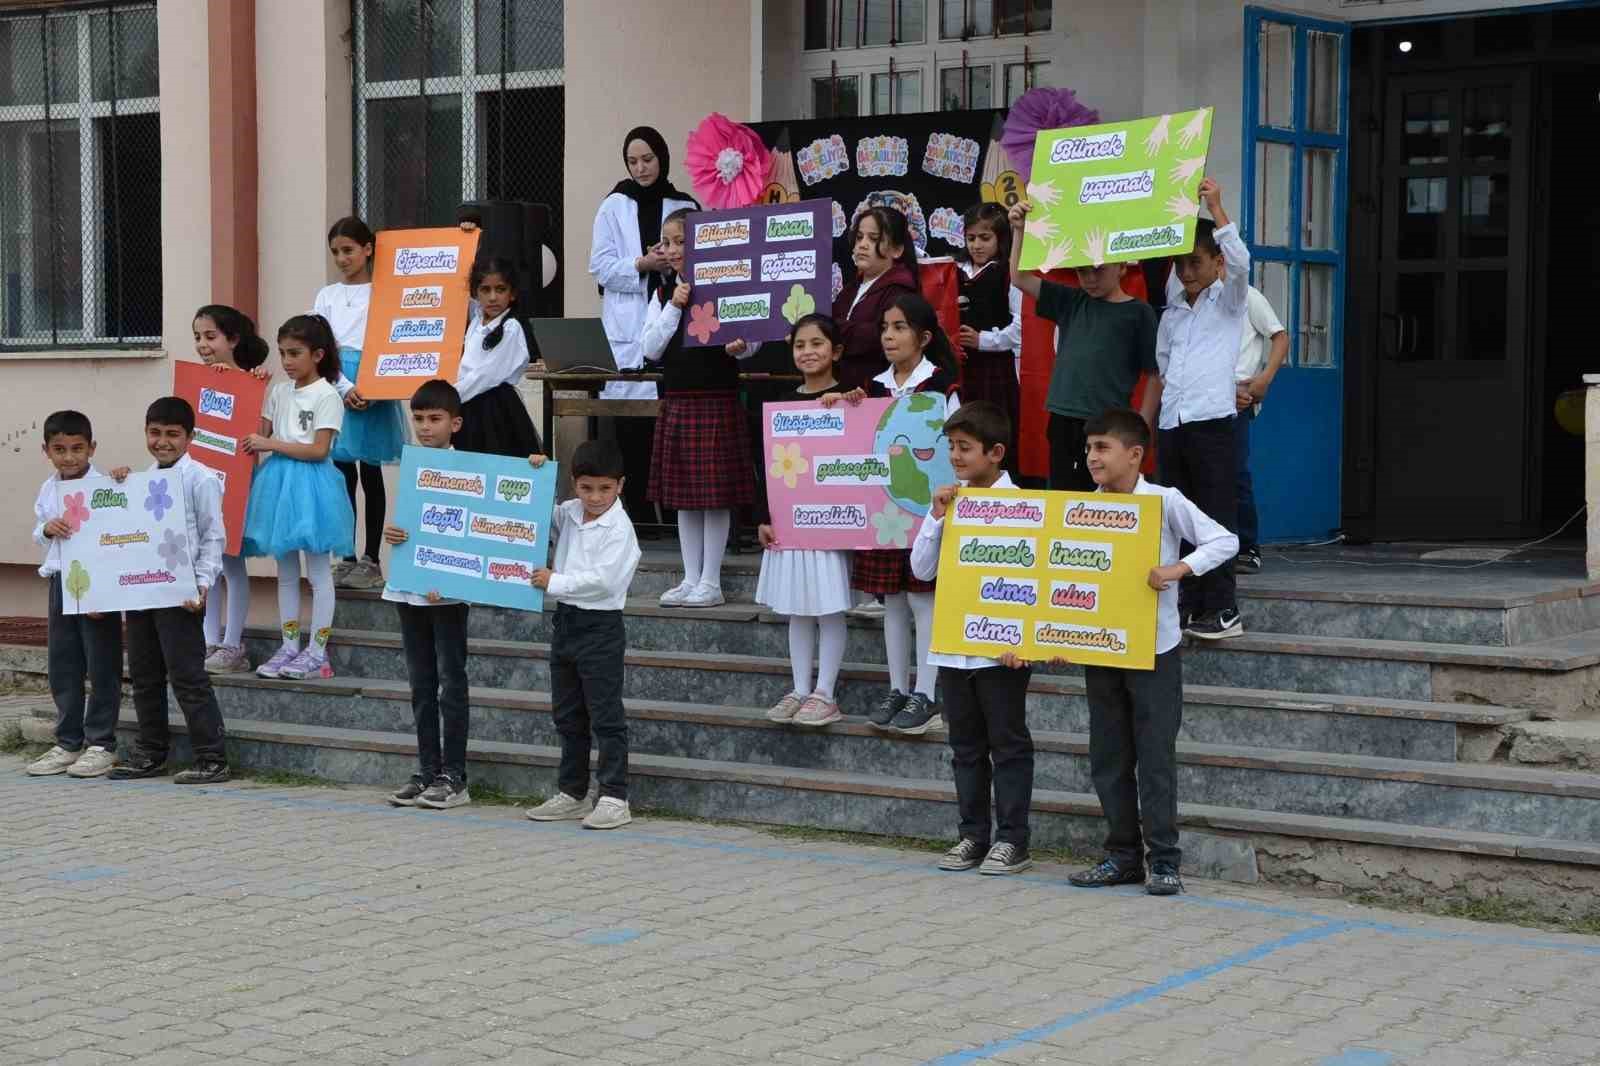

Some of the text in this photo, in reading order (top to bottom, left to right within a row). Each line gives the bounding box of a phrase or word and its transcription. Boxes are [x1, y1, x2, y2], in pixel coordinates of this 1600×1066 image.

[1052, 135, 1124, 163] Bilmek
[1080, 171, 1153, 203] yapmak
[697, 222, 749, 247] Bilgisiz
[767, 217, 812, 239] insan
[396, 250, 457, 274] Öğrenim
[695, 259, 750, 285] meyvesiz
[762, 251, 815, 280] ağaca
[402, 288, 441, 307] aklın
[719, 298, 769, 320] benzer
[390, 320, 443, 342] gücünü
[772, 413, 843, 435] İlköğretim
[816, 457, 889, 483] geleceğin
[418, 469, 531, 502] Bilmemek ayıp
[90, 488, 128, 510] Bilen
[794, 506, 866, 528] temelidir
[957, 497, 1138, 530] İlköğretim davası
[471, 516, 535, 542] bilmediğini
[416, 547, 482, 573] öğrenmemek
[959, 538, 1111, 571] demek insan
[980, 576, 1096, 609] olma ulus
[965, 617, 1126, 651] olma davasıdır.
